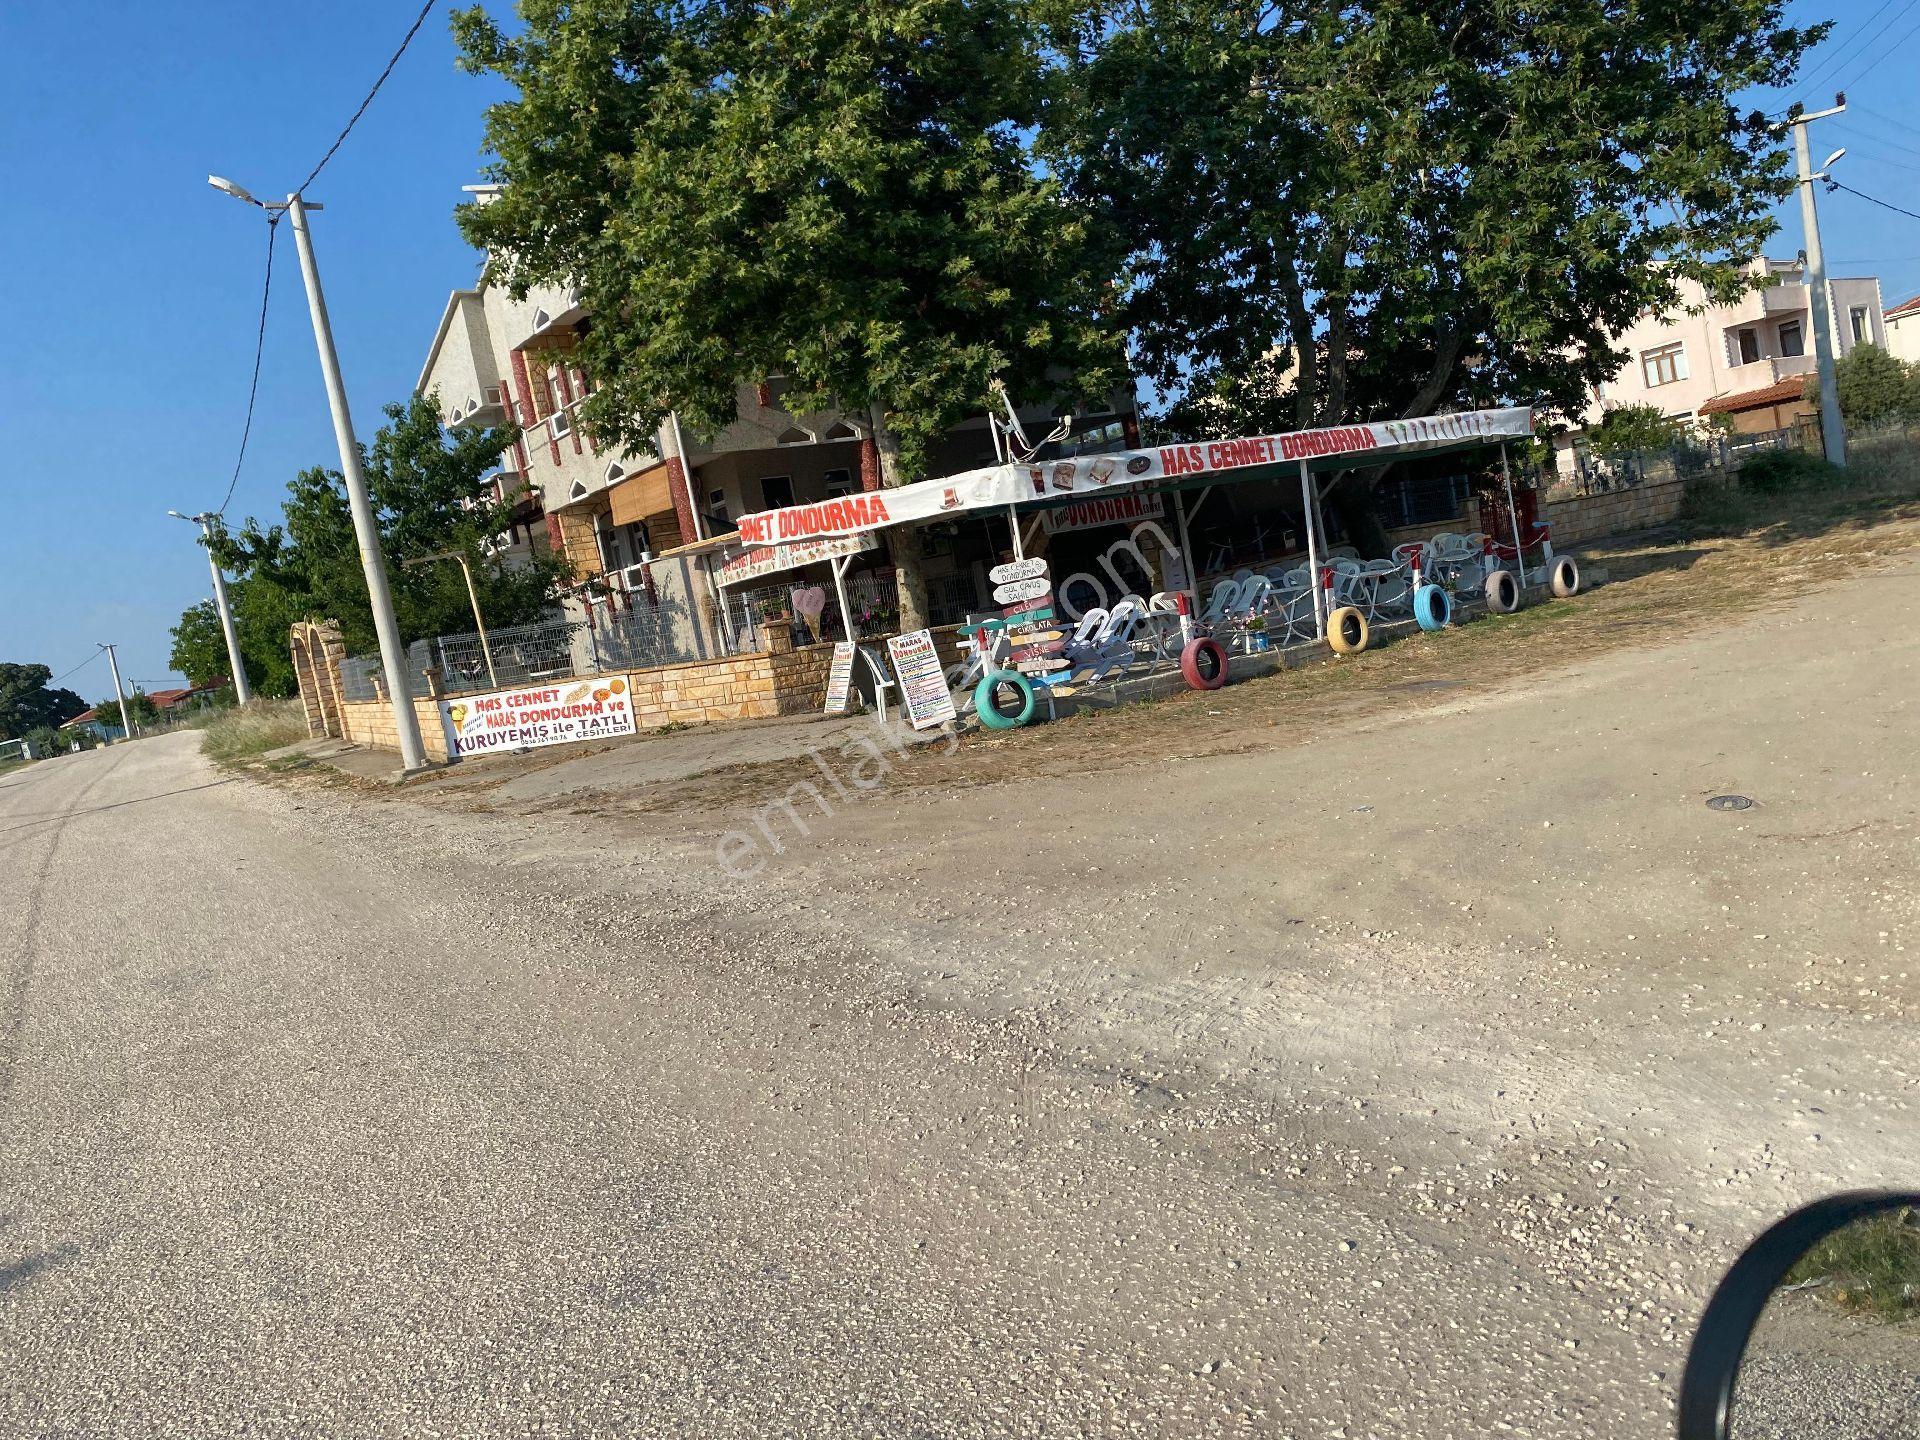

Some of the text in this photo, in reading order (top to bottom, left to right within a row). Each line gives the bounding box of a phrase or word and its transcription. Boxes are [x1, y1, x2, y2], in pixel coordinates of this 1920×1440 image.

[1160, 426, 1378, 477] HAS CENNET DONDURMA
[778, 494, 890, 540] DONDURMA
[893, 641, 932, 660] DONDURMA
[474, 689, 560, 714] HAS CENNET
[485, 712, 516, 730] MARAŞ
[519, 699, 605, 725] DONDURMA
[607, 700, 625, 713] ve
[452, 722, 550, 755] KURUYEMİŞ
[552, 722, 575, 734] ile
[578, 713, 629, 731] TATLI
